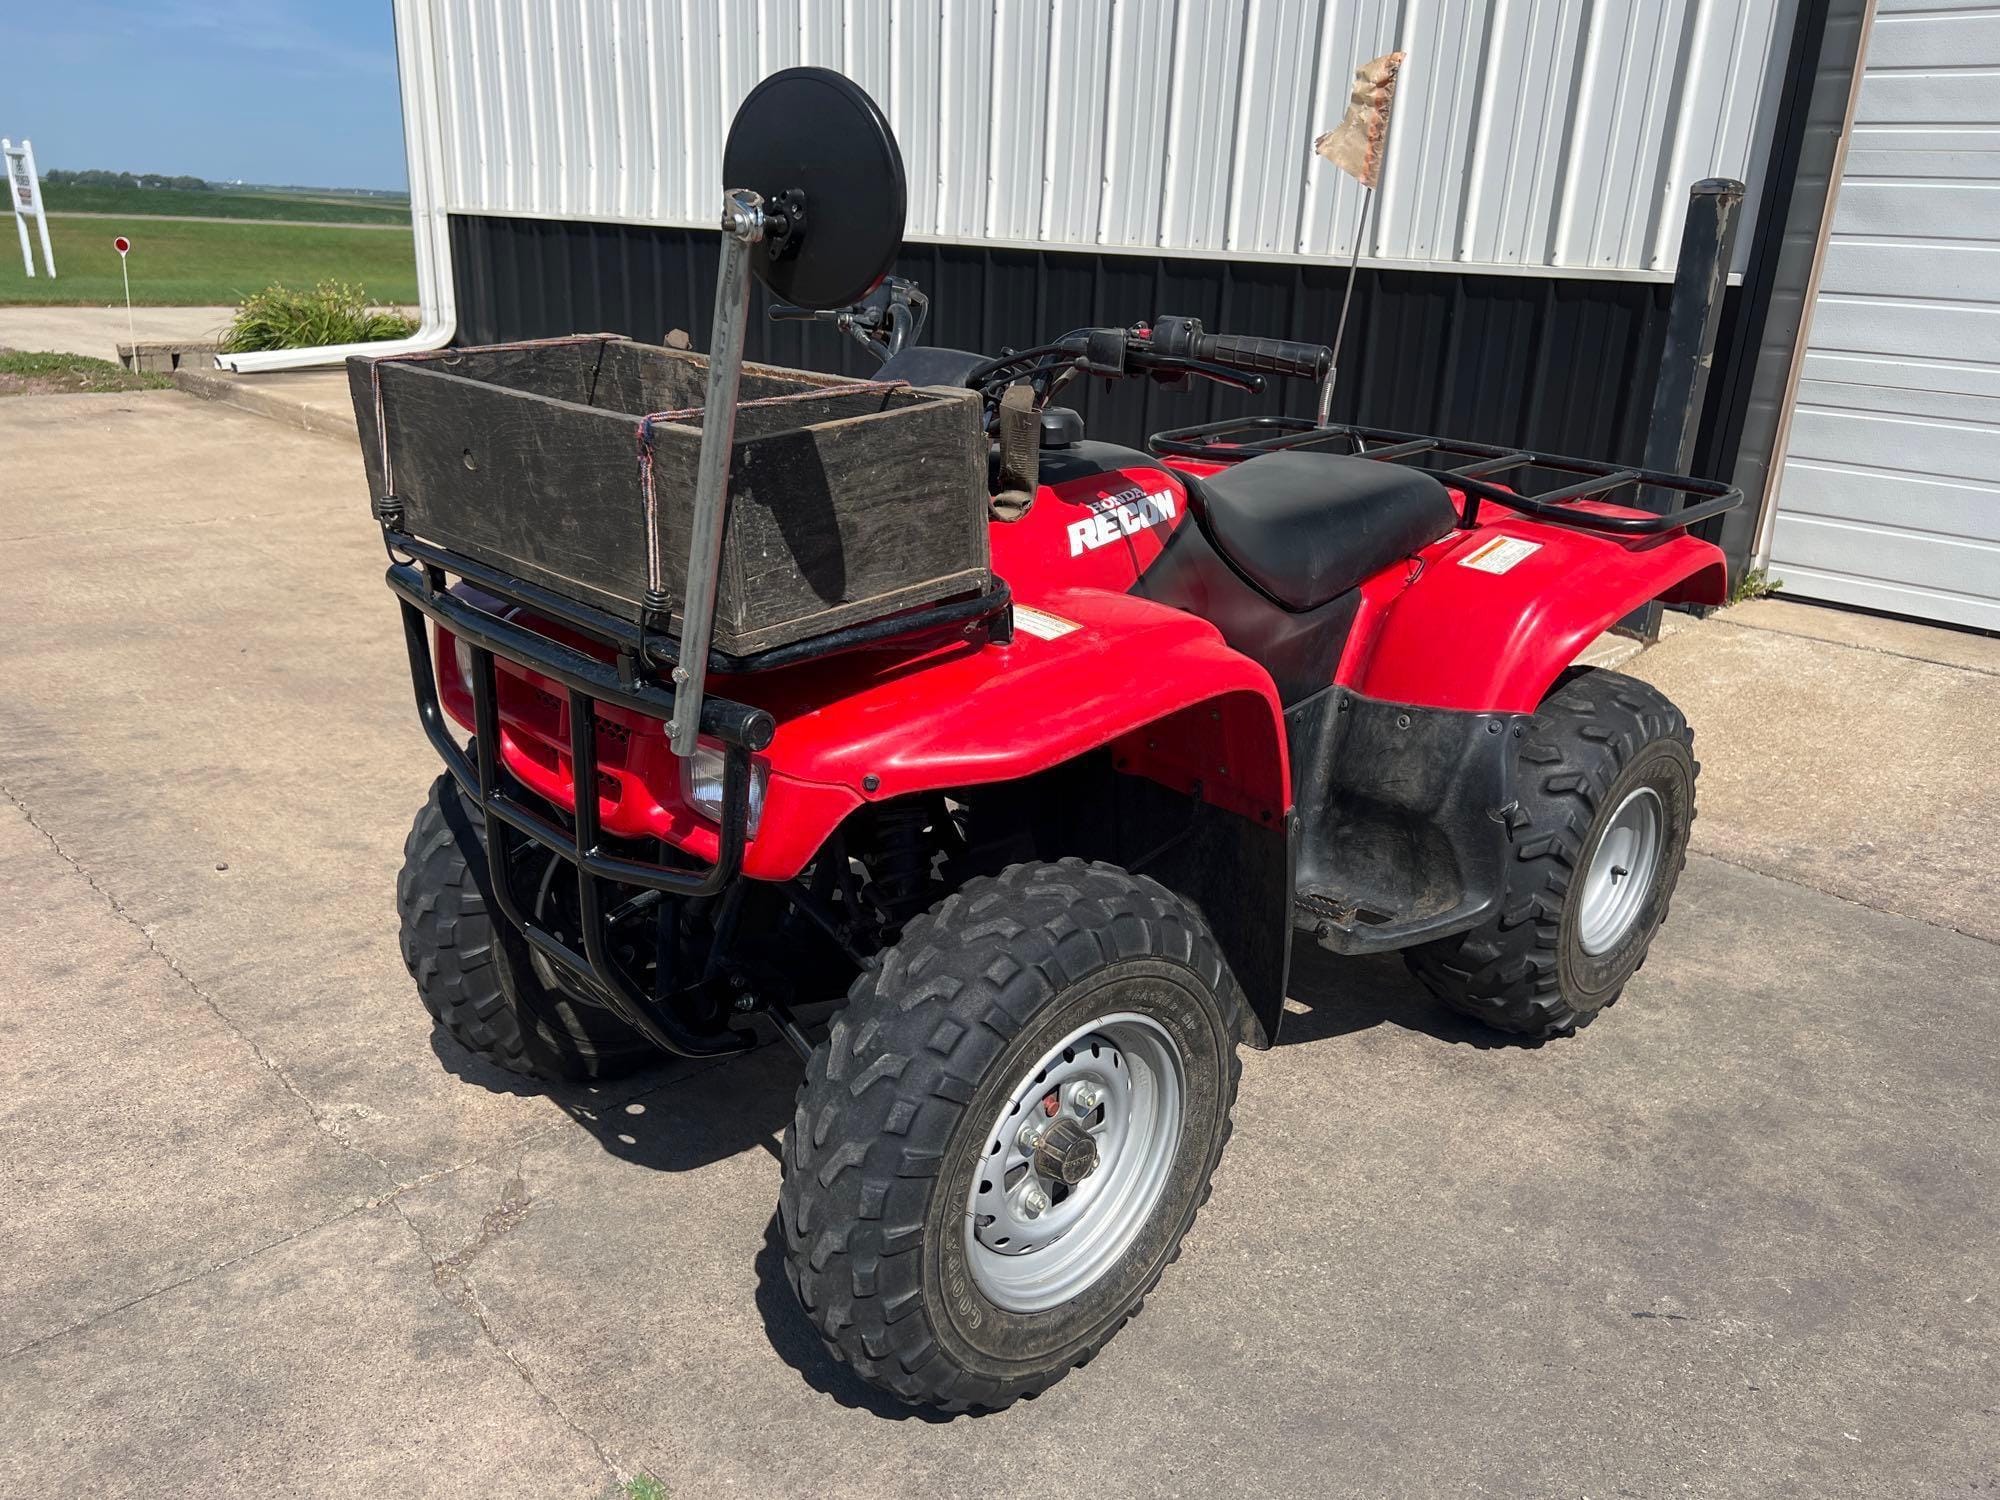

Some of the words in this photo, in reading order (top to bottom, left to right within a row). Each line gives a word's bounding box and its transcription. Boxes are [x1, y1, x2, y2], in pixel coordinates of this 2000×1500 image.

[1066, 489, 1177, 558] RECON
[1091, 487, 1145, 513] HONDA
[946, 1108, 999, 1330] GOODYEAR
